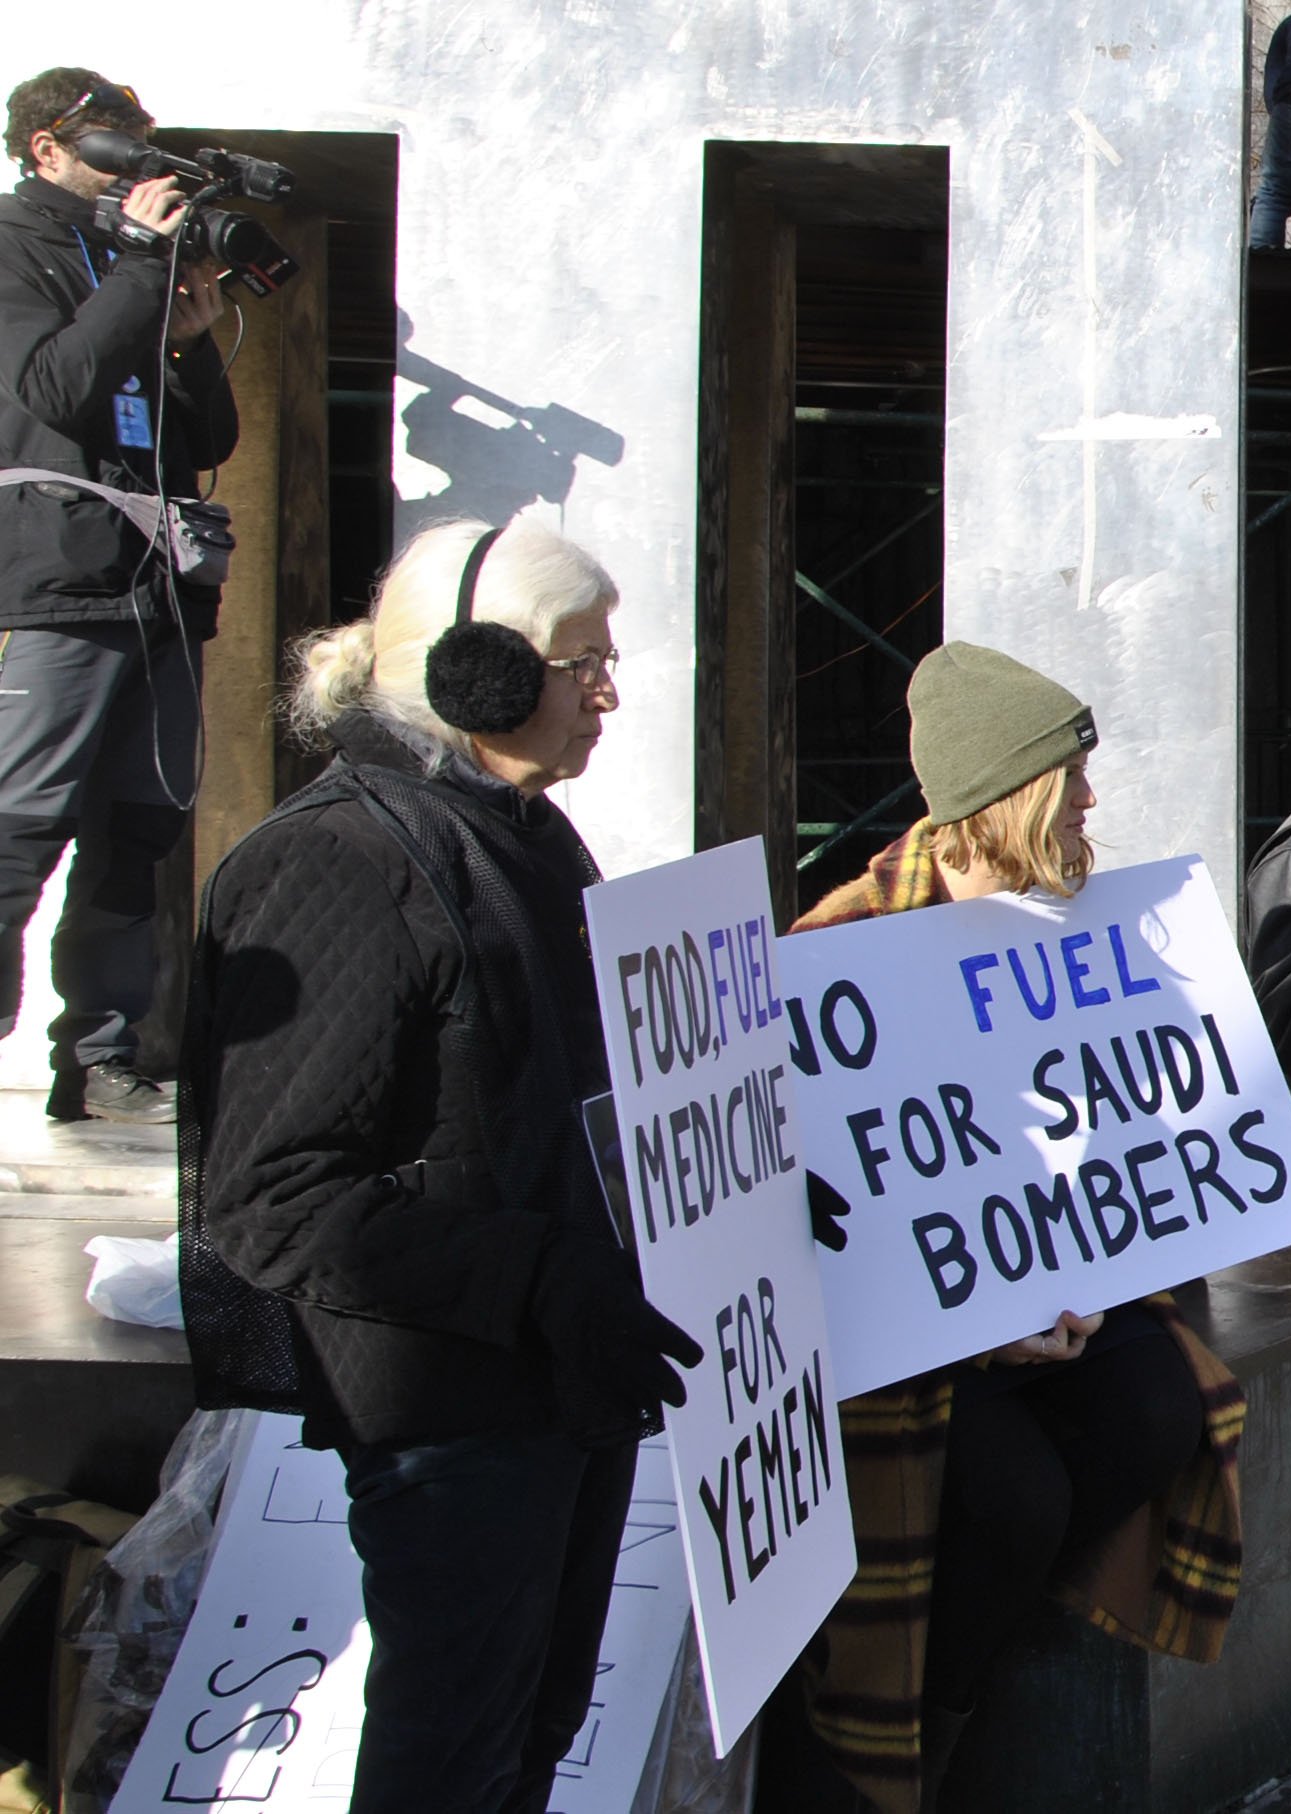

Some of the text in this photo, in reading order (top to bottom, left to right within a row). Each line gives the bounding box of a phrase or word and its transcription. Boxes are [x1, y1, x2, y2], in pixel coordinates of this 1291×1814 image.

[957, 923, 1163, 1034] FUEL
[634, 1064, 796, 1244] MEDICINE
[845, 1013, 1241, 1197] FOR SAUDI
[911, 1108, 1288, 1310] BOMBERS
[716, 1276, 787, 1424] FOR
[698, 1349, 832, 1605] YEMEN
